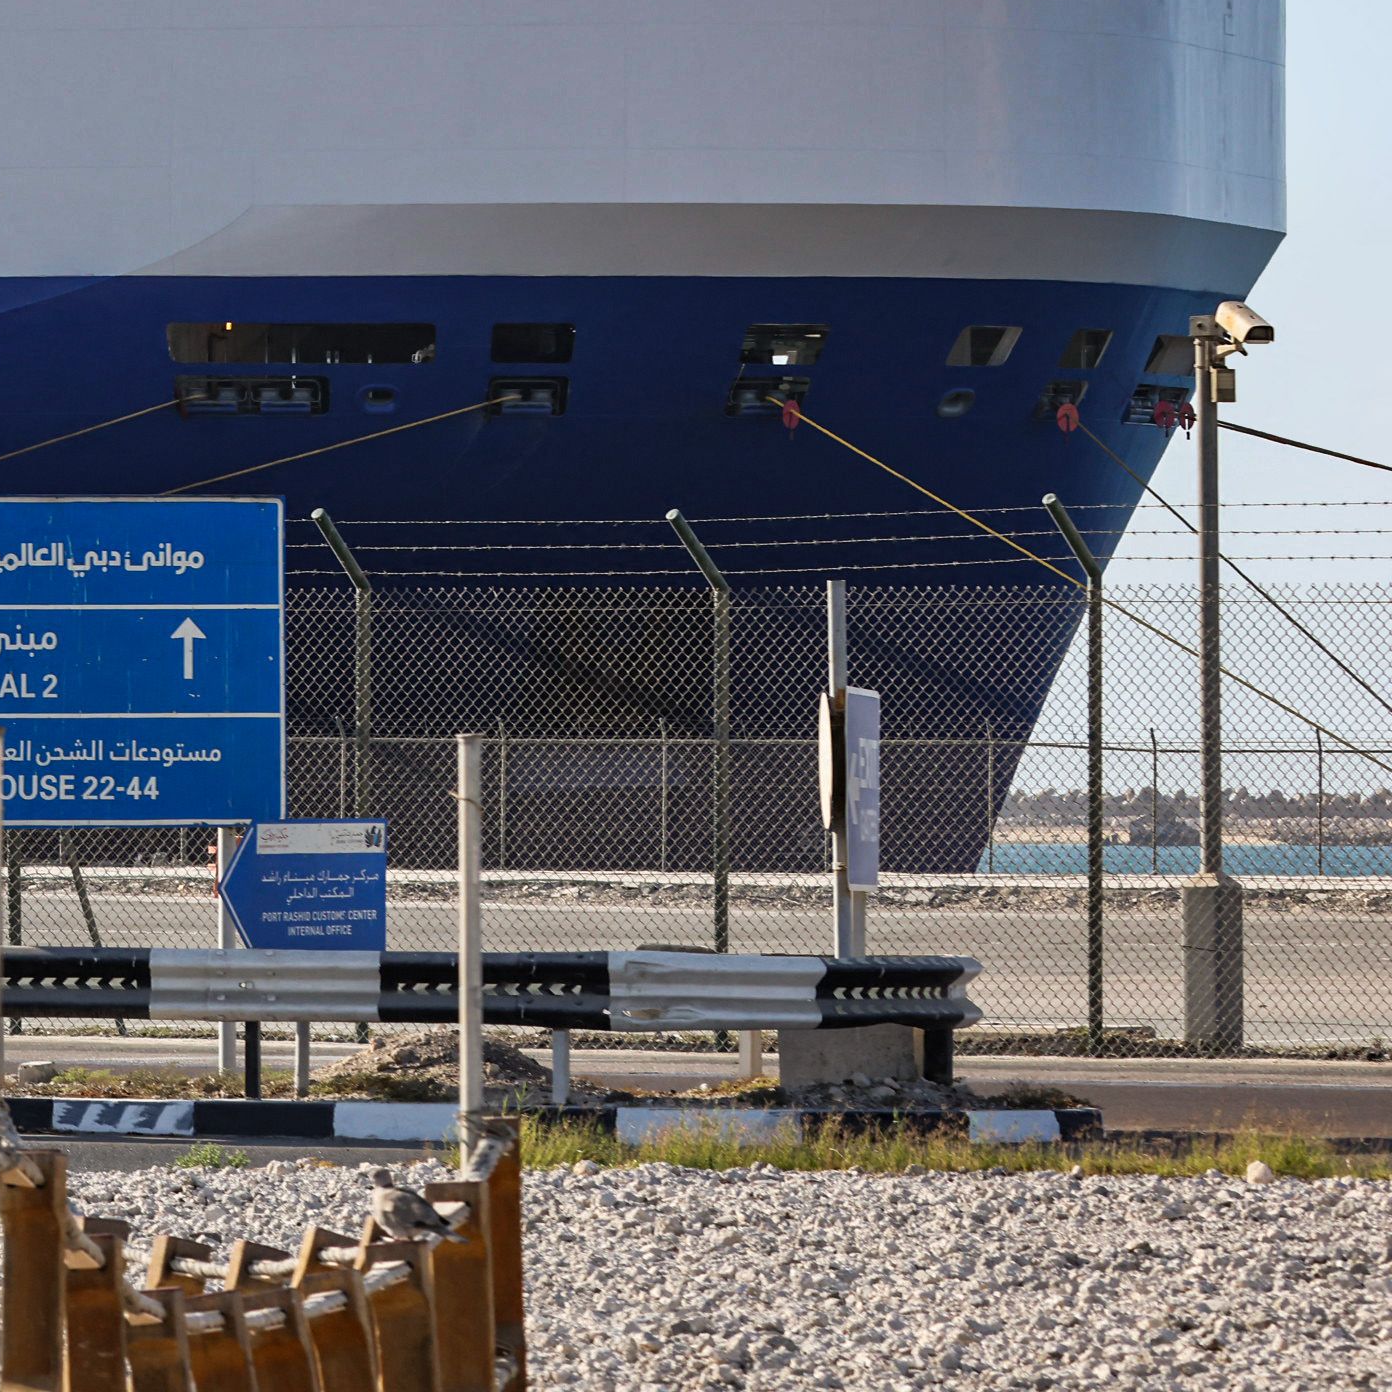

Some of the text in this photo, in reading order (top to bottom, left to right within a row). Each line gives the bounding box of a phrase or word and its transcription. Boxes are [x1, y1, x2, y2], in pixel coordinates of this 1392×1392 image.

[67, 550, 121, 578] دبي
[124, 542, 205, 575] موانئ
[42, 674, 58, 698] 2
[35, 739, 103, 766] الشحن
[109, 740, 222, 767] مستودعات
[82, 775, 159, 800] 22-44
[261, 911, 283, 923] PORT
[283, 911, 311, 922] RASHID
[347, 909, 378, 921] CENTER
[287, 924, 353, 937] INTERNAL OFFICE
